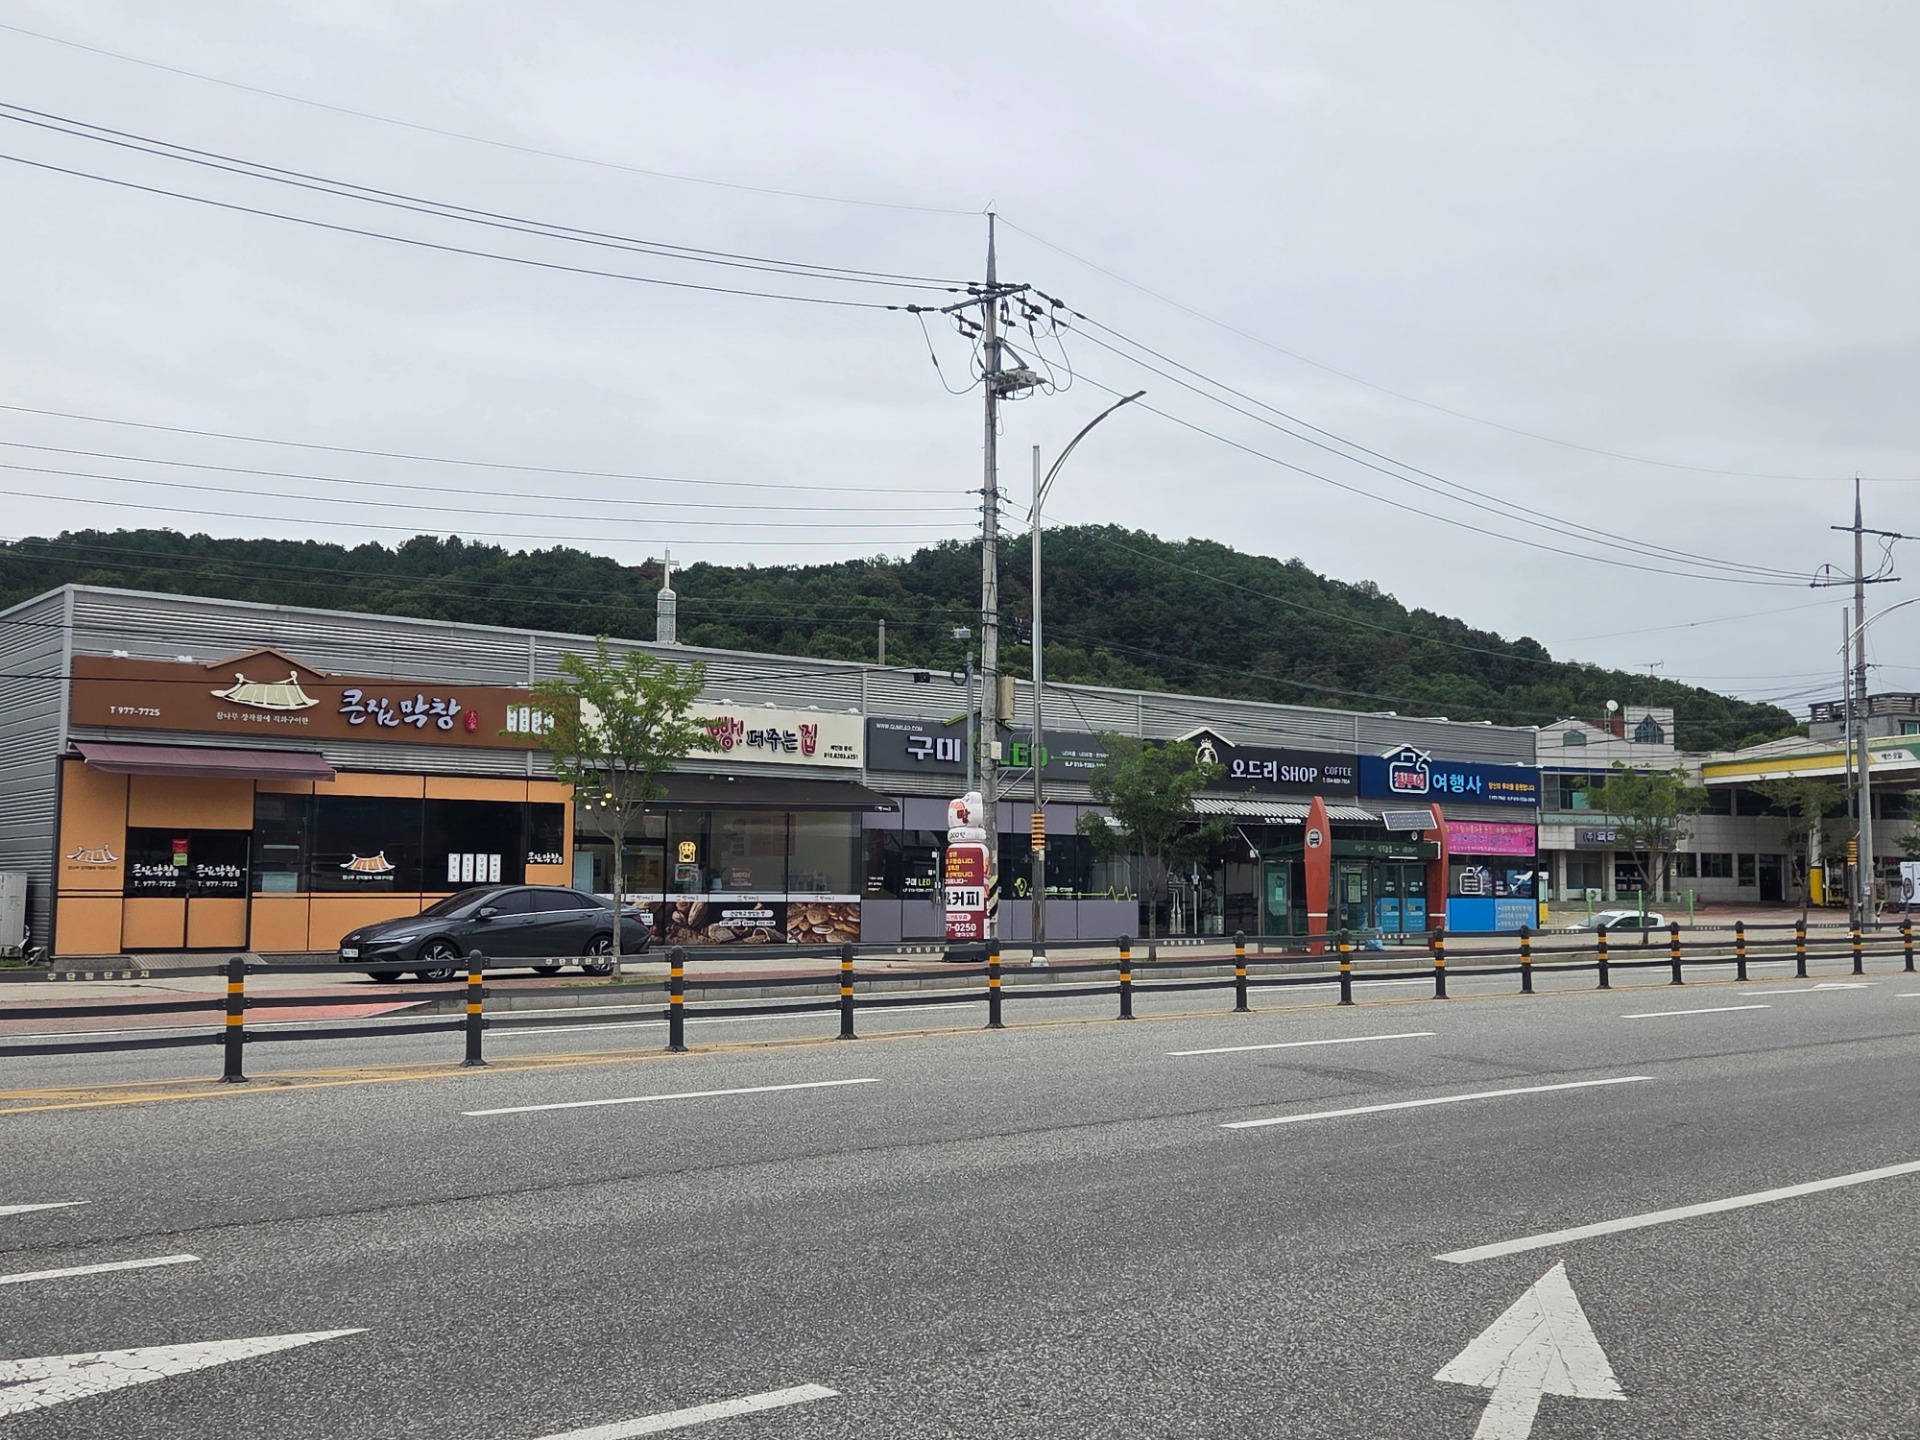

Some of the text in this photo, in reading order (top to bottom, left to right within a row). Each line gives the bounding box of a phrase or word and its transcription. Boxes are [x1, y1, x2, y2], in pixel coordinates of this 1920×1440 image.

[110, 706, 161, 717] T 977-7725
[216, 711, 238, 721] 참나무
[746, 728, 798, 753] 퍼주는
[799, 723, 818, 756] 집
[907, 735, 961, 762] 구미
[1231, 759, 1318, 782] 오드리 SHOP
[1324, 766, 1352, 777] COFFEE
[1432, 773, 1482, 794] 여행사
[918, 878, 931, 886] LED
